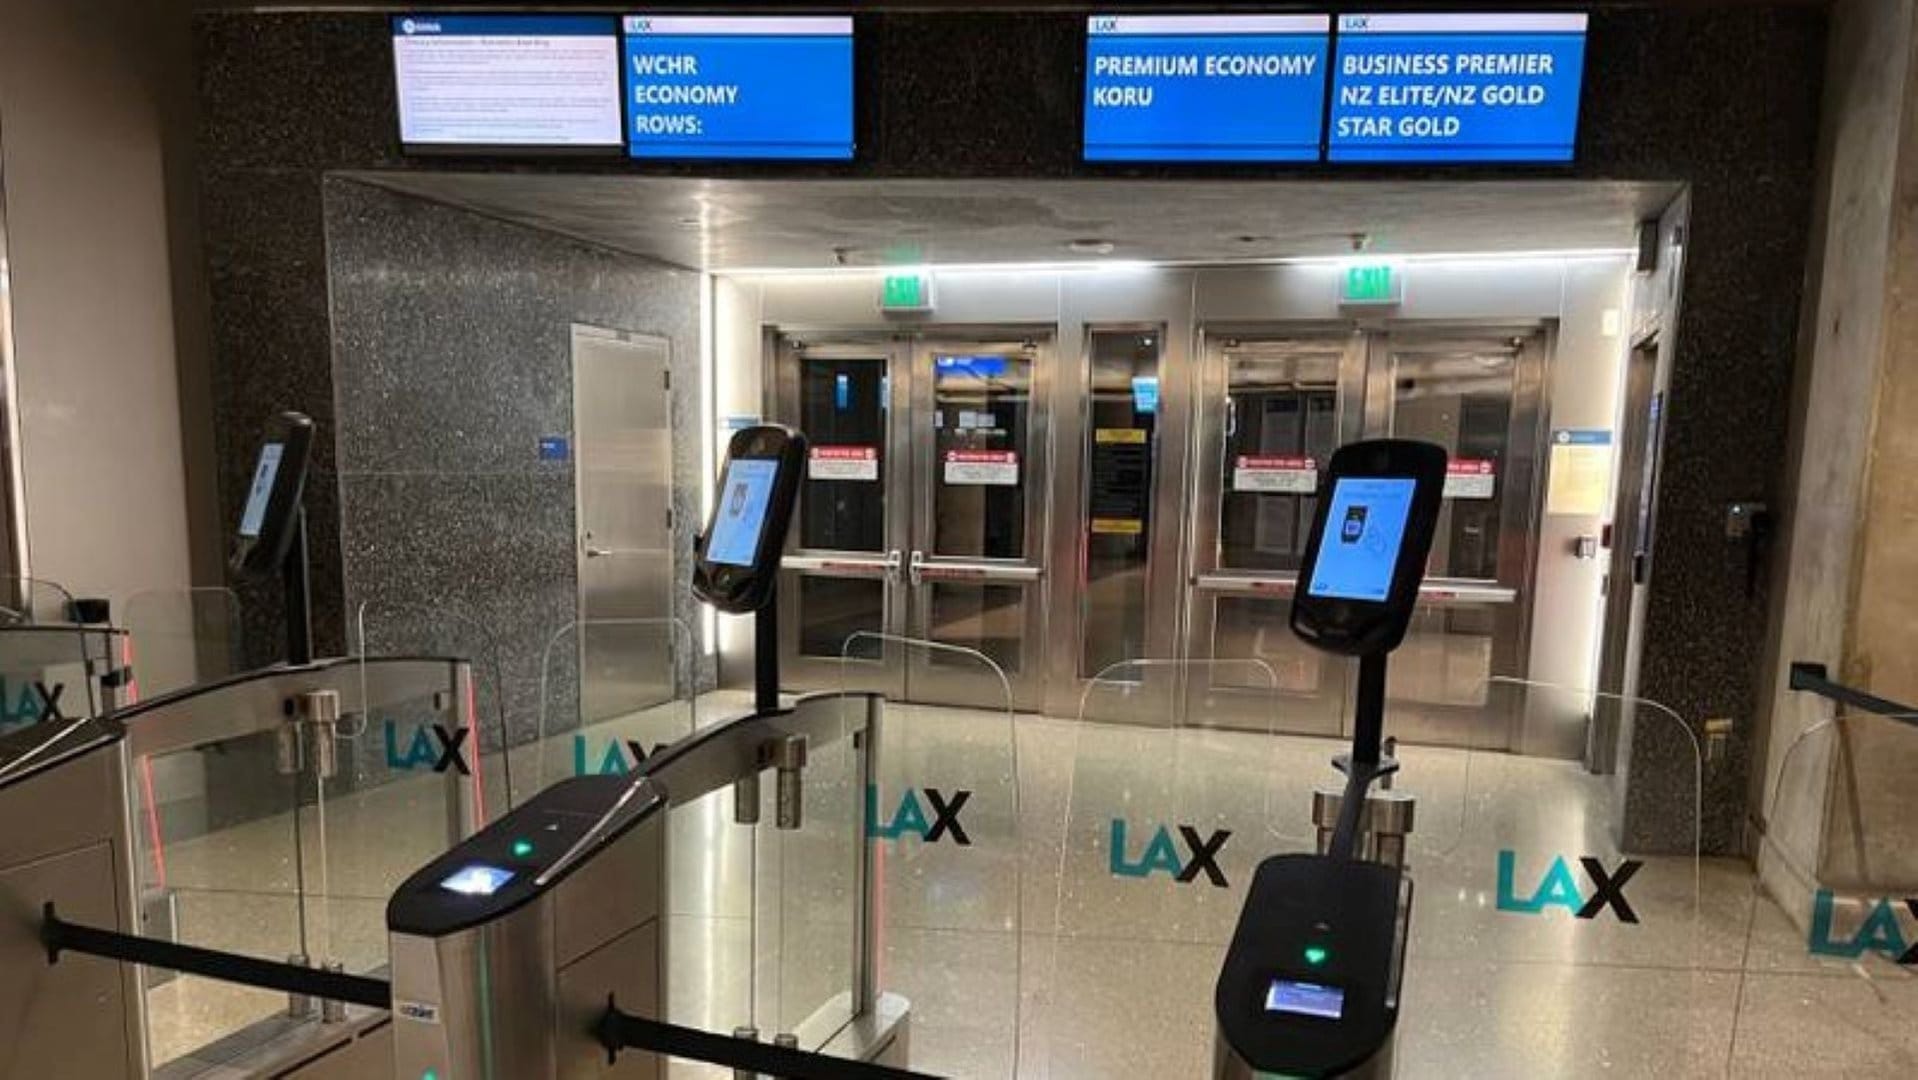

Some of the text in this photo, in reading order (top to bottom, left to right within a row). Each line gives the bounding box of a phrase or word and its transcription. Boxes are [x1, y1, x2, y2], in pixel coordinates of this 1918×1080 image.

[633, 55, 696, 74] WCHR
[1095, 56, 1316, 75] PREMIUM ECONOMY
[1343, 54, 1553, 75] BUSINESS PREMIER
[635, 85, 737, 104] ECONOMY
[1093, 87, 1152, 106] KORU
[1341, 85, 1544, 108] NZ ELITE/NZ GOLD
[637, 115, 701, 134] ROWS:
[1339, 116, 1460, 136] STAR GOLD
[1349, 266, 1390, 299] EXIT
[0, 676, 63, 723] LAX
[385, 720, 470, 775] LAX
[866, 784, 972, 846] LAX
[1110, 818, 1231, 888] LAX
[1496, 849, 1644, 924] LAX
